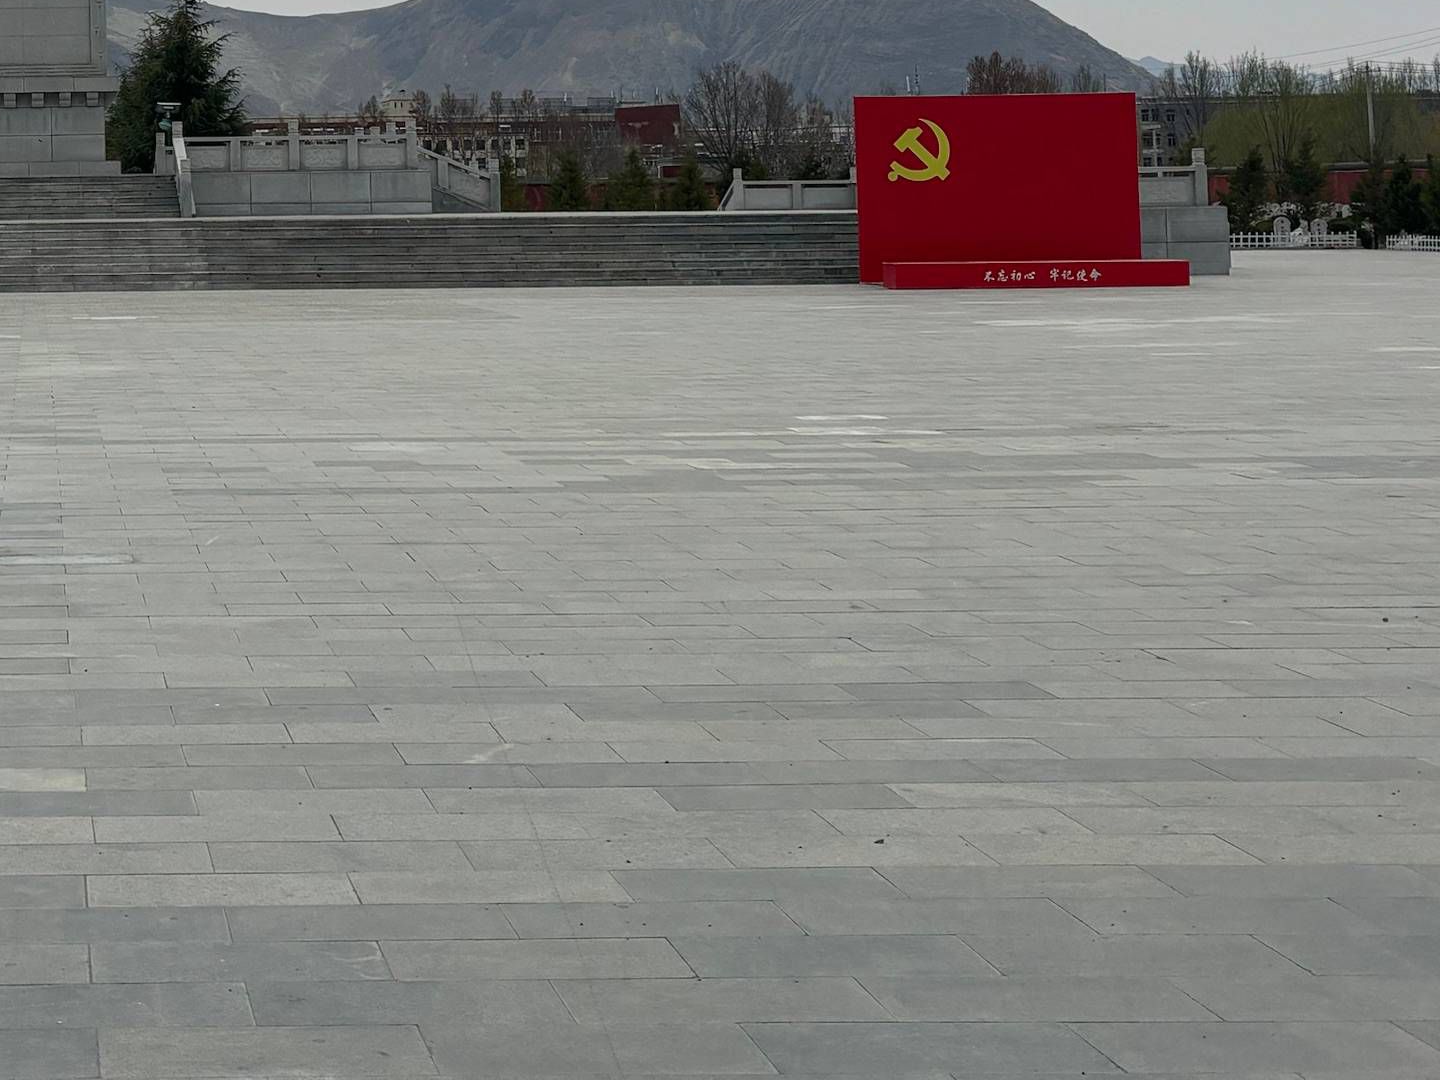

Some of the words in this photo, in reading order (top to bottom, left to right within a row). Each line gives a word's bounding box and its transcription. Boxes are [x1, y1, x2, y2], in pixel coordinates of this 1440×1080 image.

[983, 269, 1036, 282] 不忘初心
[1049, 267, 1102, 281] 牢记使命
